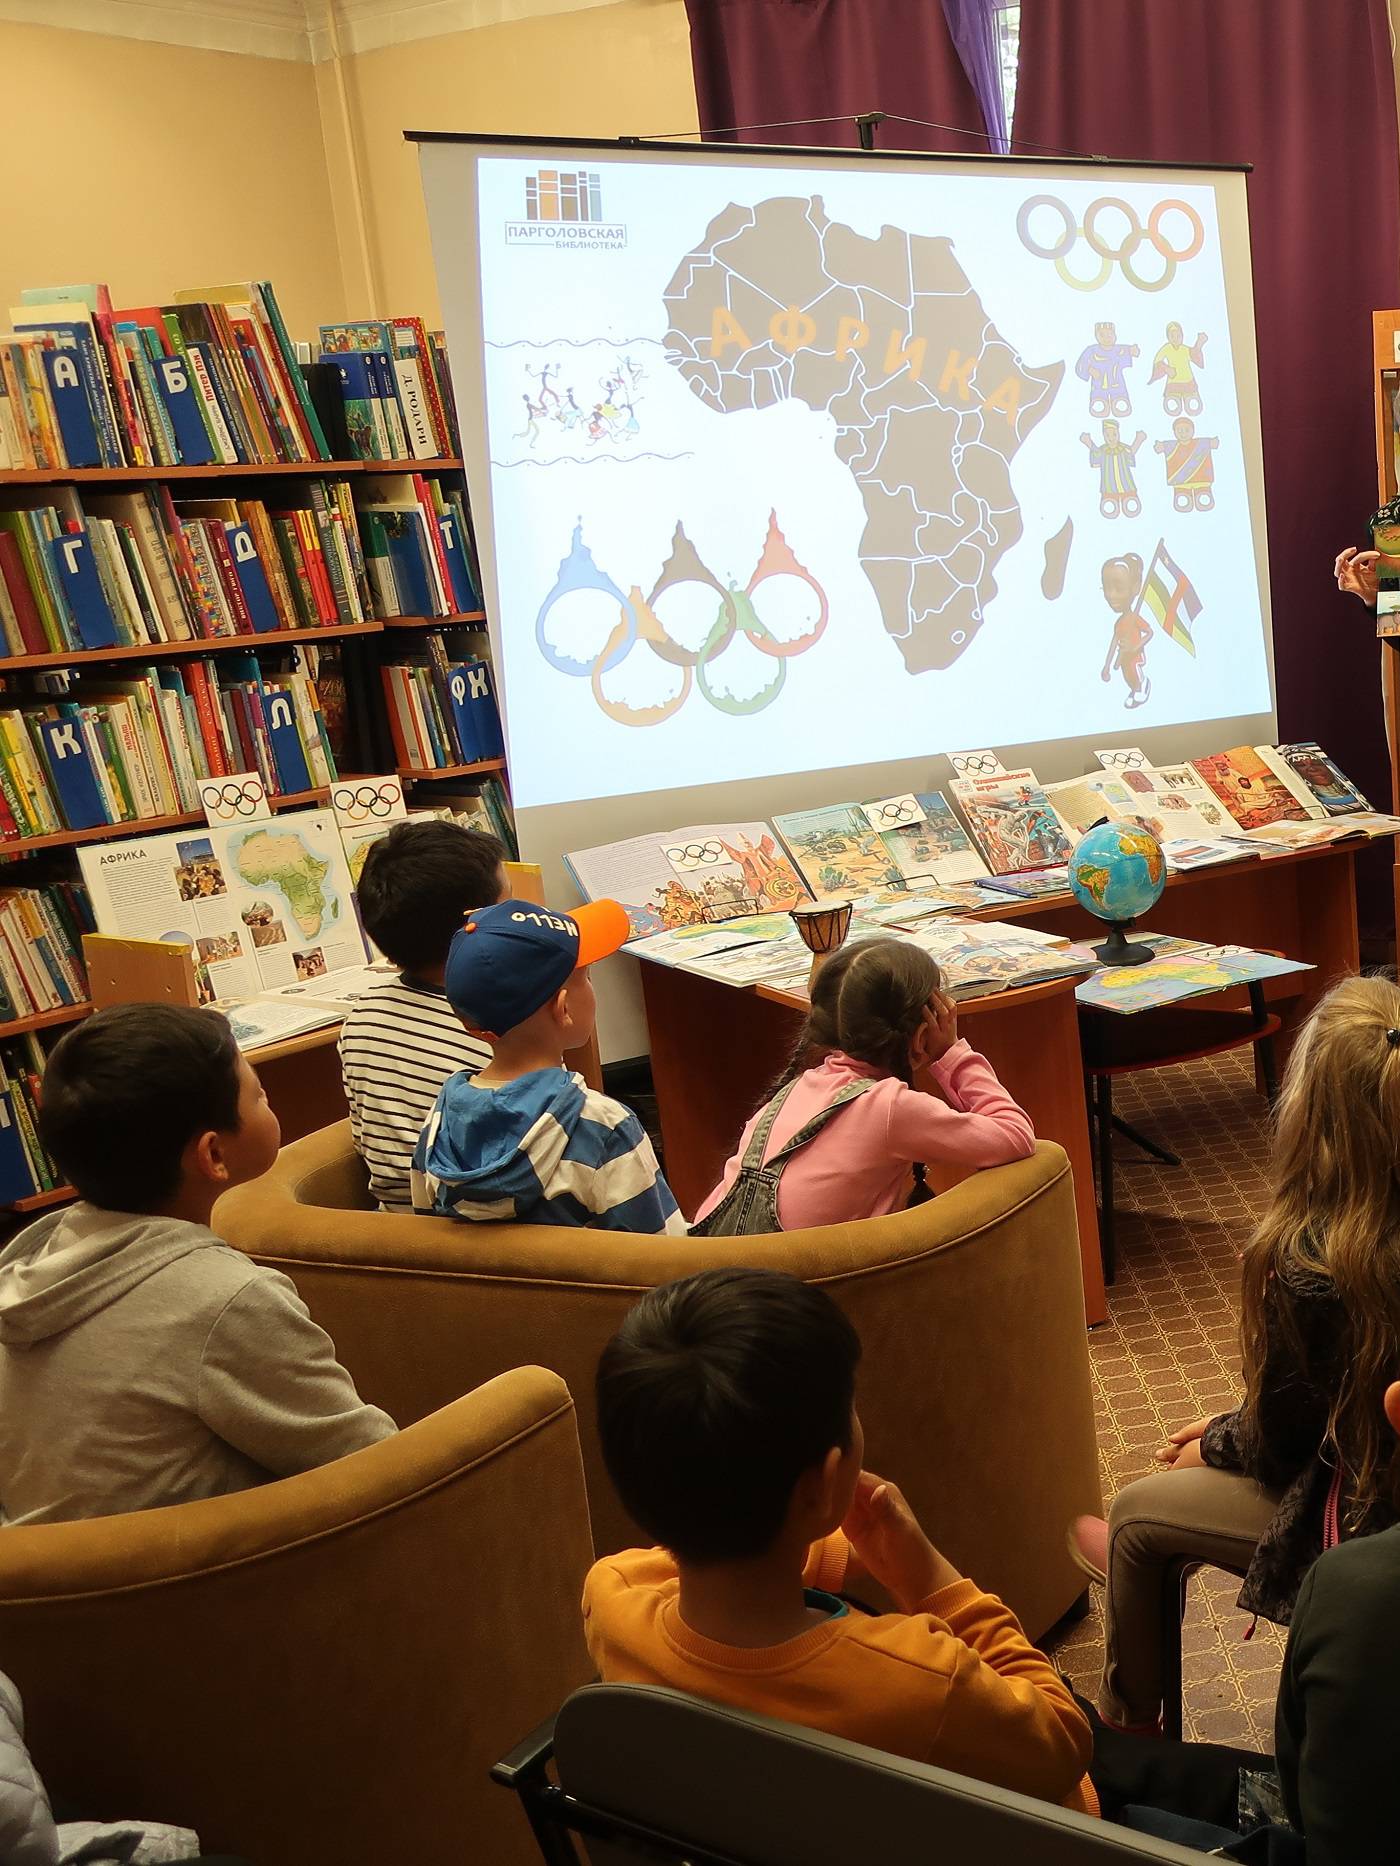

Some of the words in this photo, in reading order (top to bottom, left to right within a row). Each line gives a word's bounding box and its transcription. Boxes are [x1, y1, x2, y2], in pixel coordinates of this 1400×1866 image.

[508, 226, 624, 239] ПАРГОЛОВСКАЯ
[555, 241, 624, 250] БИБЛИОТЕКА
[53, 356, 79, 388] А
[161, 361, 188, 394] Б
[711, 304, 1021, 426] АФРИКА
[407, 390, 428, 445] РОДАРИ
[234, 531, 258, 563] Д
[440, 520, 455, 549] Т
[62, 539, 83, 574] Г
[271, 698, 293, 730] Л
[50, 724, 82, 760] К
[100, 849, 148, 865] АФРИКА
[511, 912, 579, 937] HELLO
